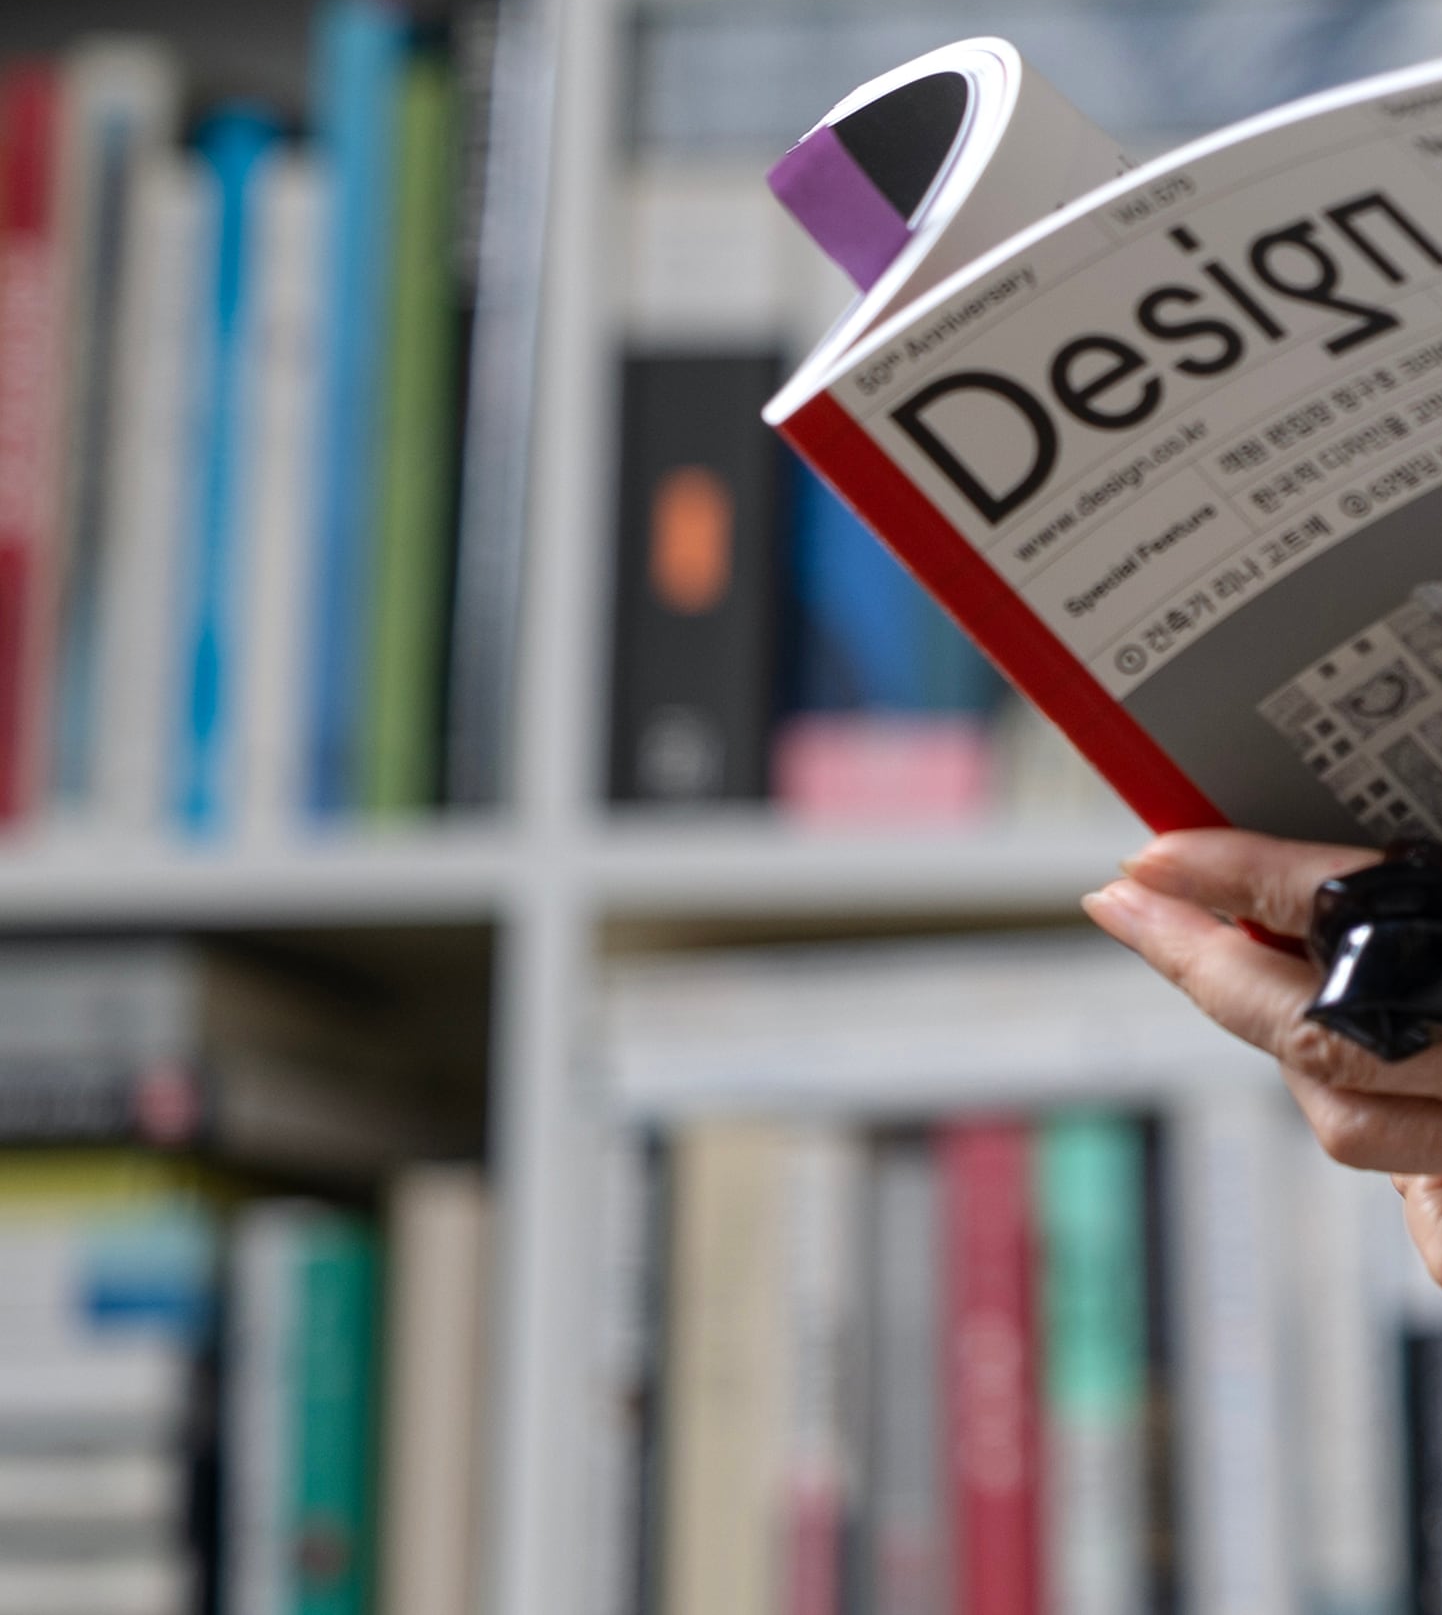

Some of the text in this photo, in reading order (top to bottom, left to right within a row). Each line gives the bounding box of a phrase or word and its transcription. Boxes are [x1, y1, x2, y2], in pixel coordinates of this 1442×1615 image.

[905, 263, 1039, 368] Anniversary
[1249, 459, 1322, 515] 한국적
[1317, 410, 1411, 470] 디자인을
[1263, 397, 1336, 451] 편집장
[1014, 417, 1212, 563] www.design.co.kr
[1062, 500, 1220, 621] Special Feature
[1212, 555, 1266, 600] 리나
